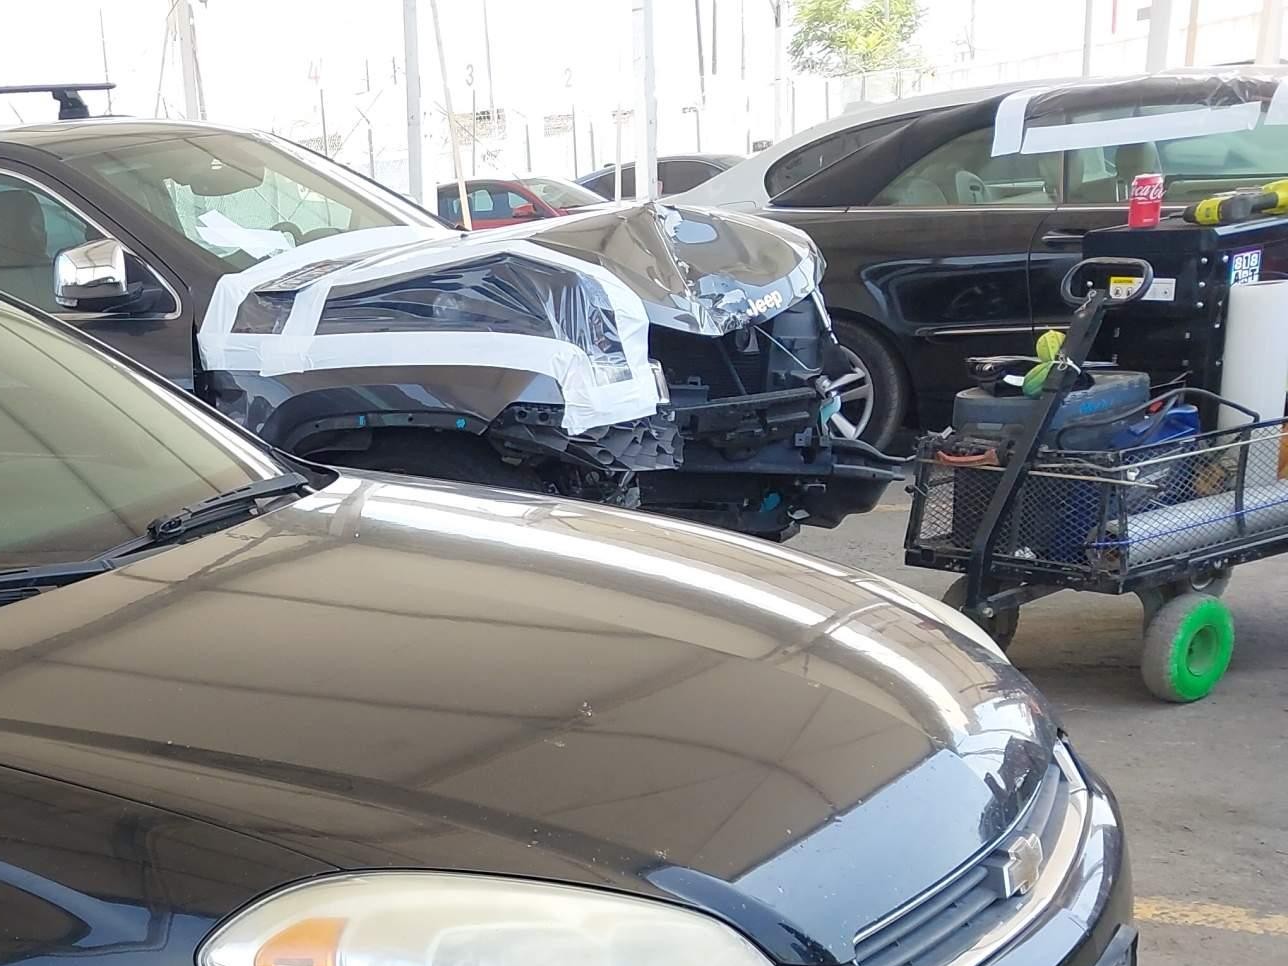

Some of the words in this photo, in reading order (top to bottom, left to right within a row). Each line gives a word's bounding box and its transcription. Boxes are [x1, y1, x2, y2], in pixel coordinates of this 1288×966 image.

[465, 64, 475, 87] 3
[564, 67, 574, 88] 2
[1234, 253, 1259, 270] 818
[746, 290, 783, 317] Jeep
